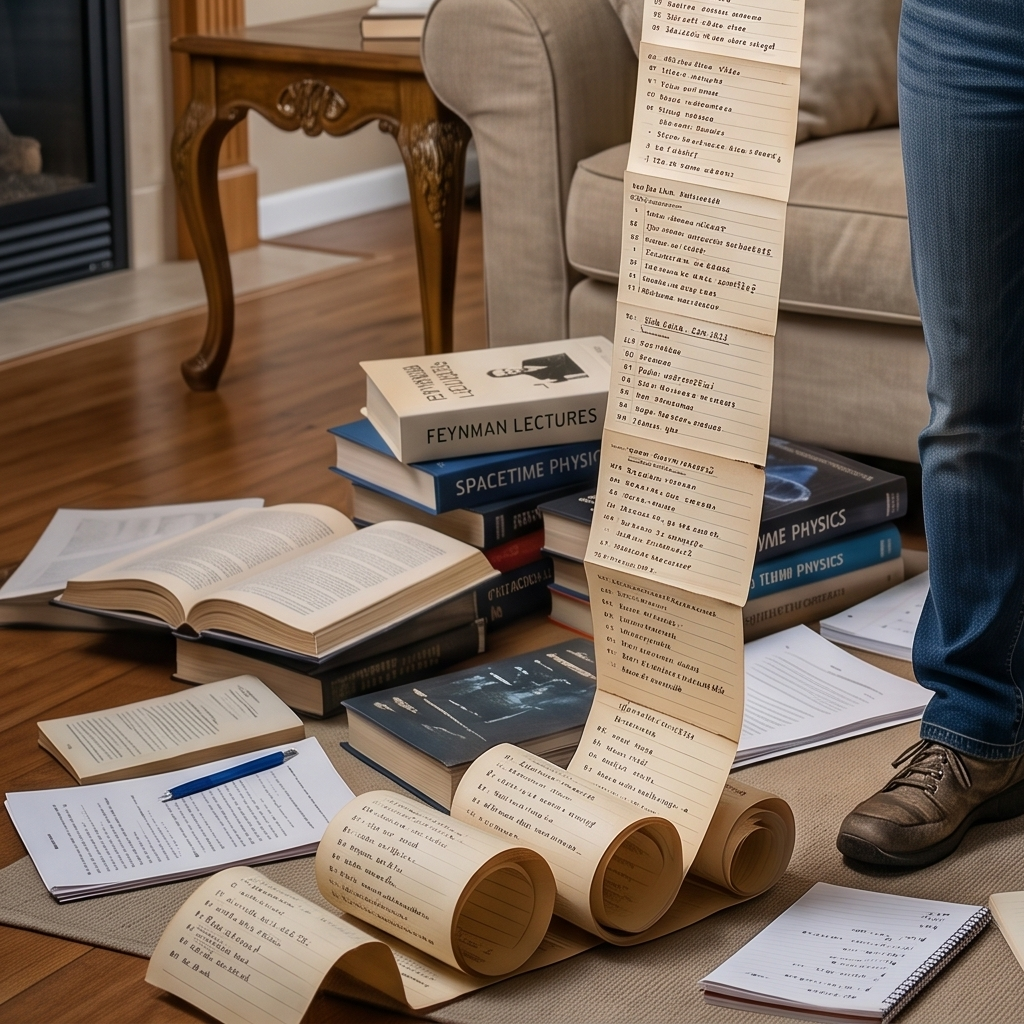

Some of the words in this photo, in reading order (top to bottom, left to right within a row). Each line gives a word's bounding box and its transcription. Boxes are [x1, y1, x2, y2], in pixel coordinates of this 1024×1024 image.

[427, 419, 508, 444] FEYNMAN
[514, 408, 598, 434] LECTURES
[455, 462, 545, 496] SPACETIME
[792, 508, 847, 541] PHYSICS
